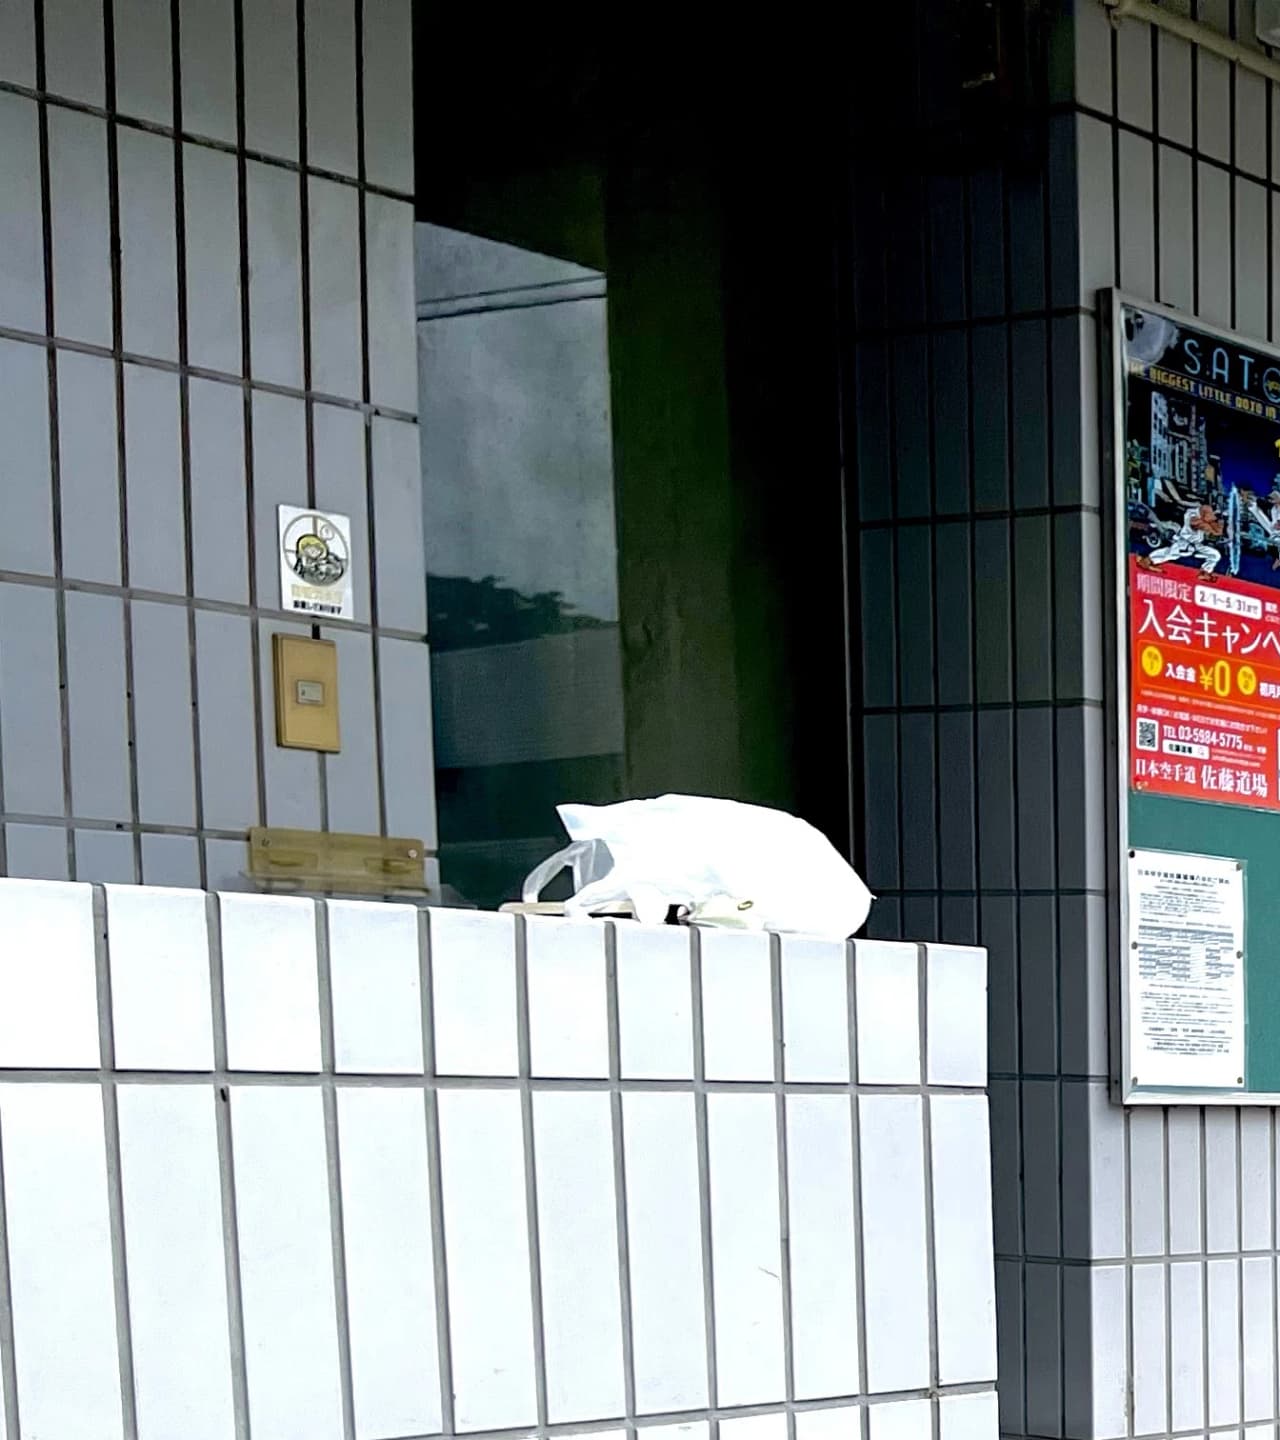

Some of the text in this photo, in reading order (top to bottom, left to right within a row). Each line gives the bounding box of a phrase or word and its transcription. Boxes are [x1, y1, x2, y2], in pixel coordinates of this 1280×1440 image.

[1136, 759, 1268, 798] 日本空手道 佐藤道場
